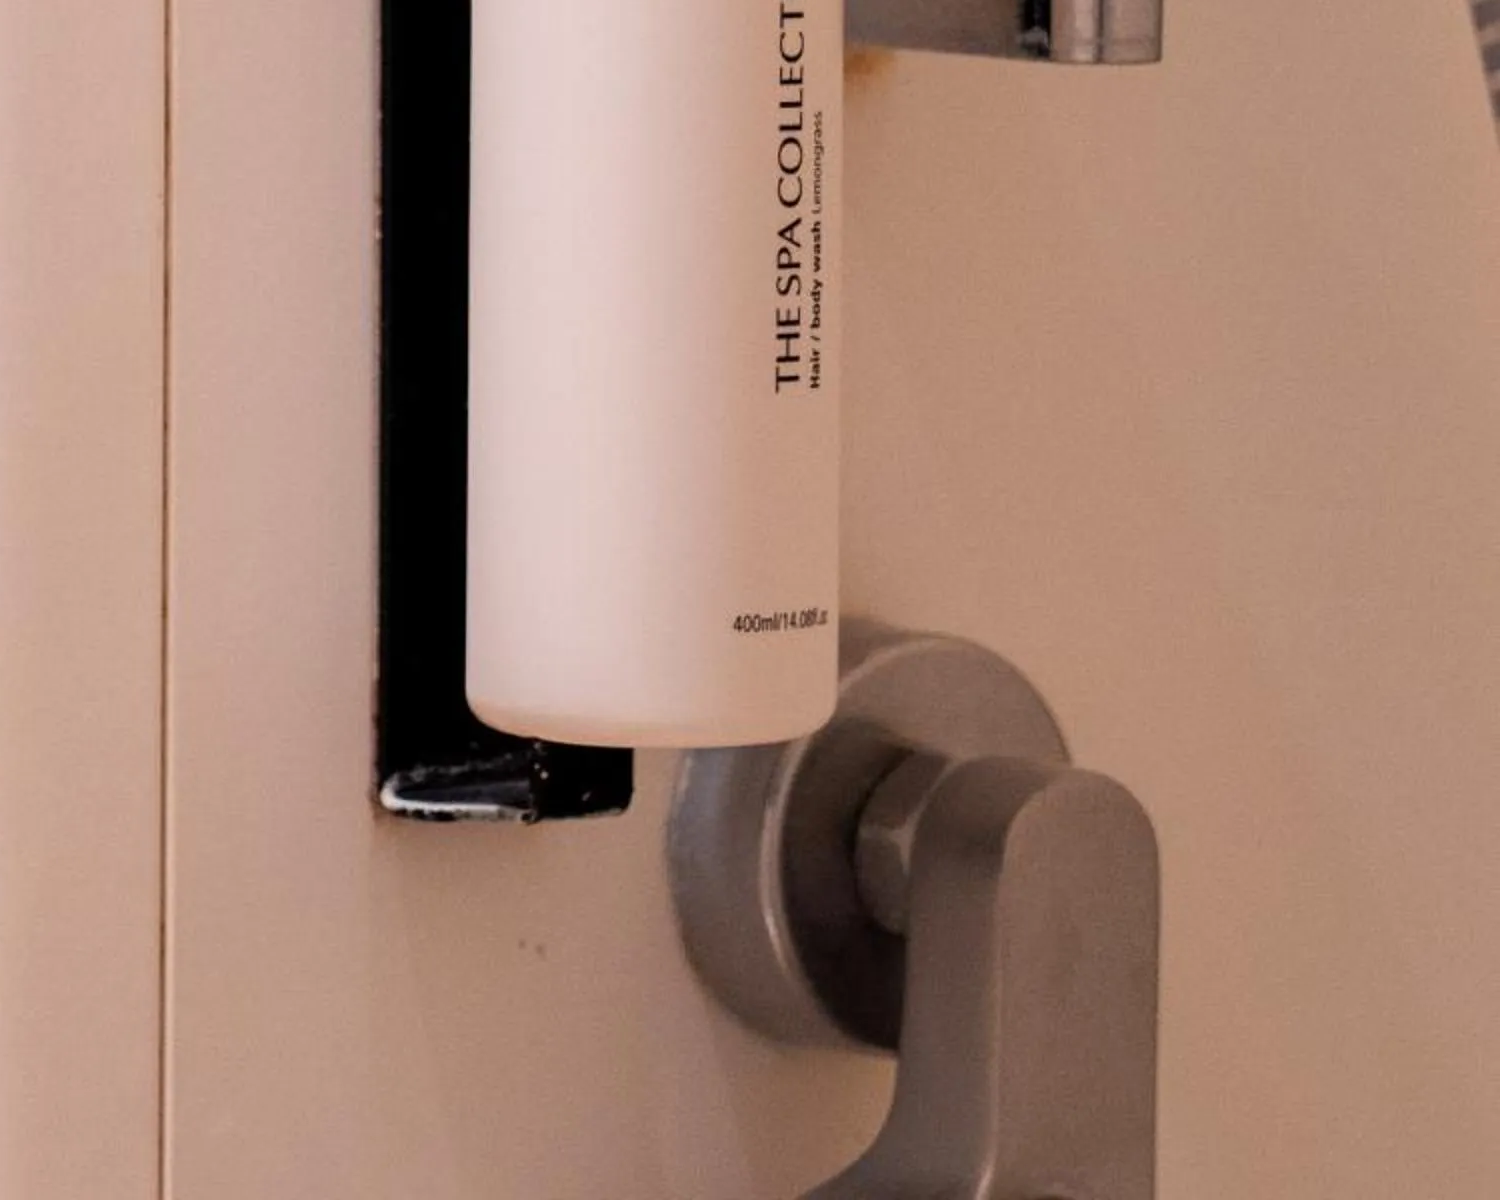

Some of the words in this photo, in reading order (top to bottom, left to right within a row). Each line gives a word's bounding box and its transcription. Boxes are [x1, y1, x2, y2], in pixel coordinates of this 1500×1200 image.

[810, 110, 825, 215] Lemongrass
[775, 216, 804, 298] SPA
[810, 219, 823, 274] wash
[808, 278, 824, 331] body
[774, 305, 802, 395] THE
[808, 347, 821, 390] Hair
